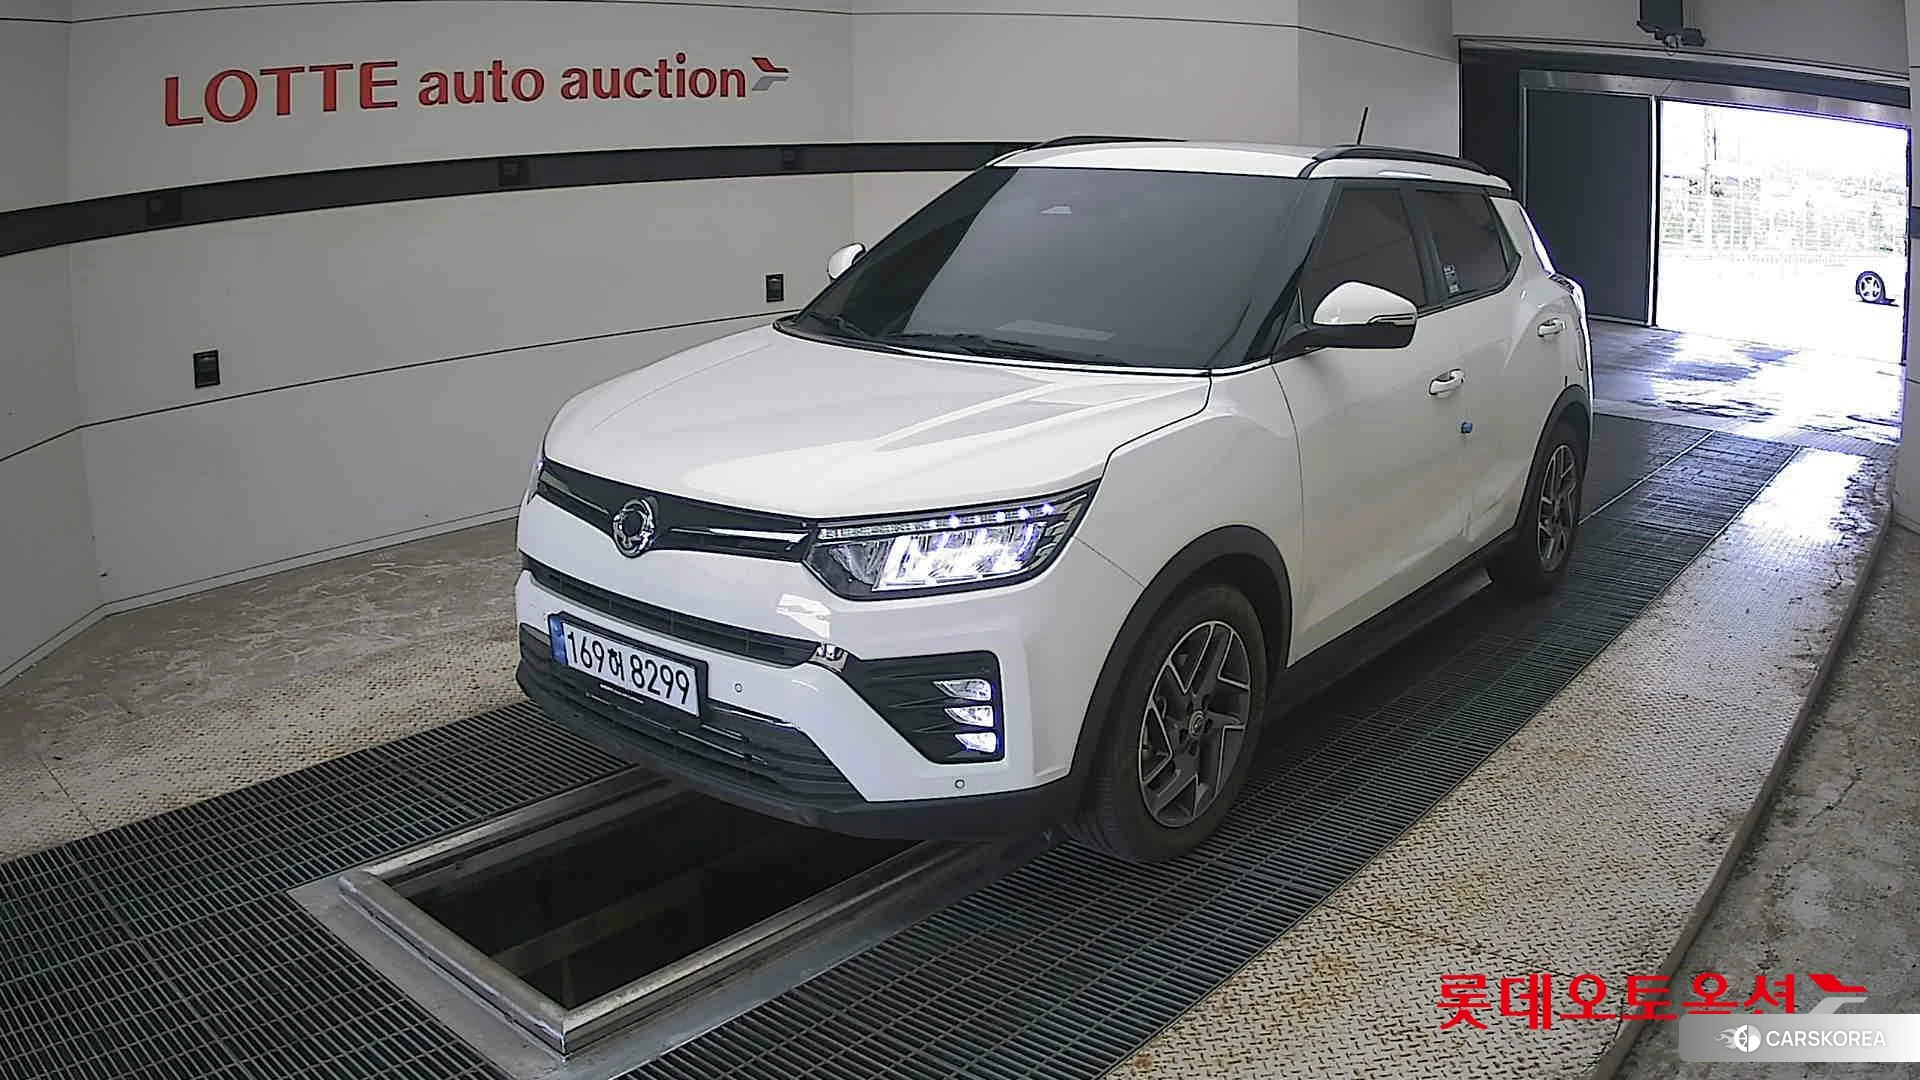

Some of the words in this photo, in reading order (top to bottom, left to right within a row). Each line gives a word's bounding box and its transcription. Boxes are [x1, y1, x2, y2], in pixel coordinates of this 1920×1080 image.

[164, 60, 399, 127] LOTTE
[417, 59, 545, 106] auto
[560, 53, 747, 100] auction
[630, 654, 690, 705] 8299
